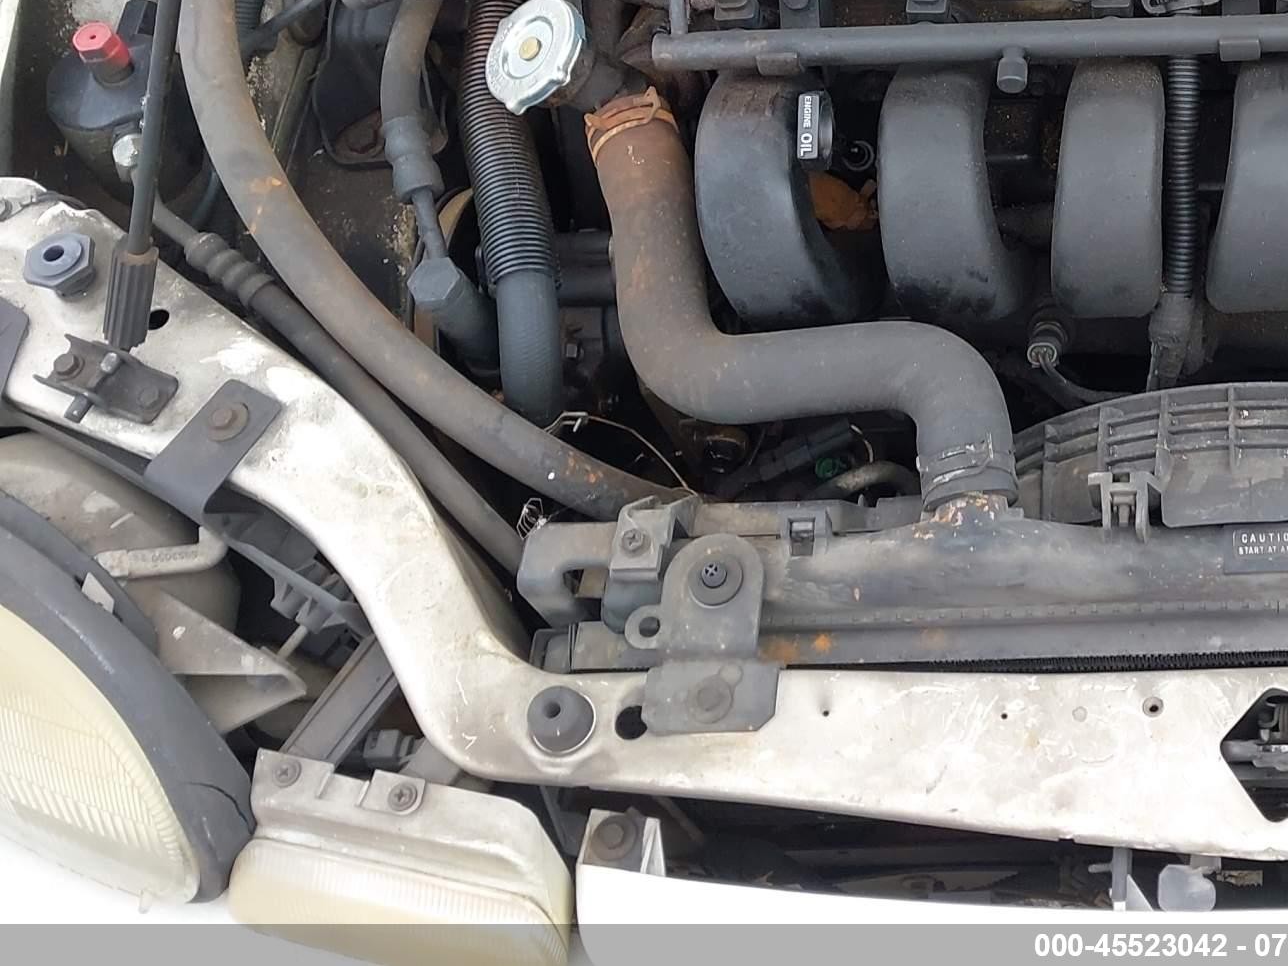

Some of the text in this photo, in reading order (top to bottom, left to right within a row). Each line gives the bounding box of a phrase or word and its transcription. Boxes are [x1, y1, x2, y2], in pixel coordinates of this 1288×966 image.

[803, 95, 812, 128] ENGINE
[800, 132, 813, 157] OIL
[1238, 546, 1265, 555] START
